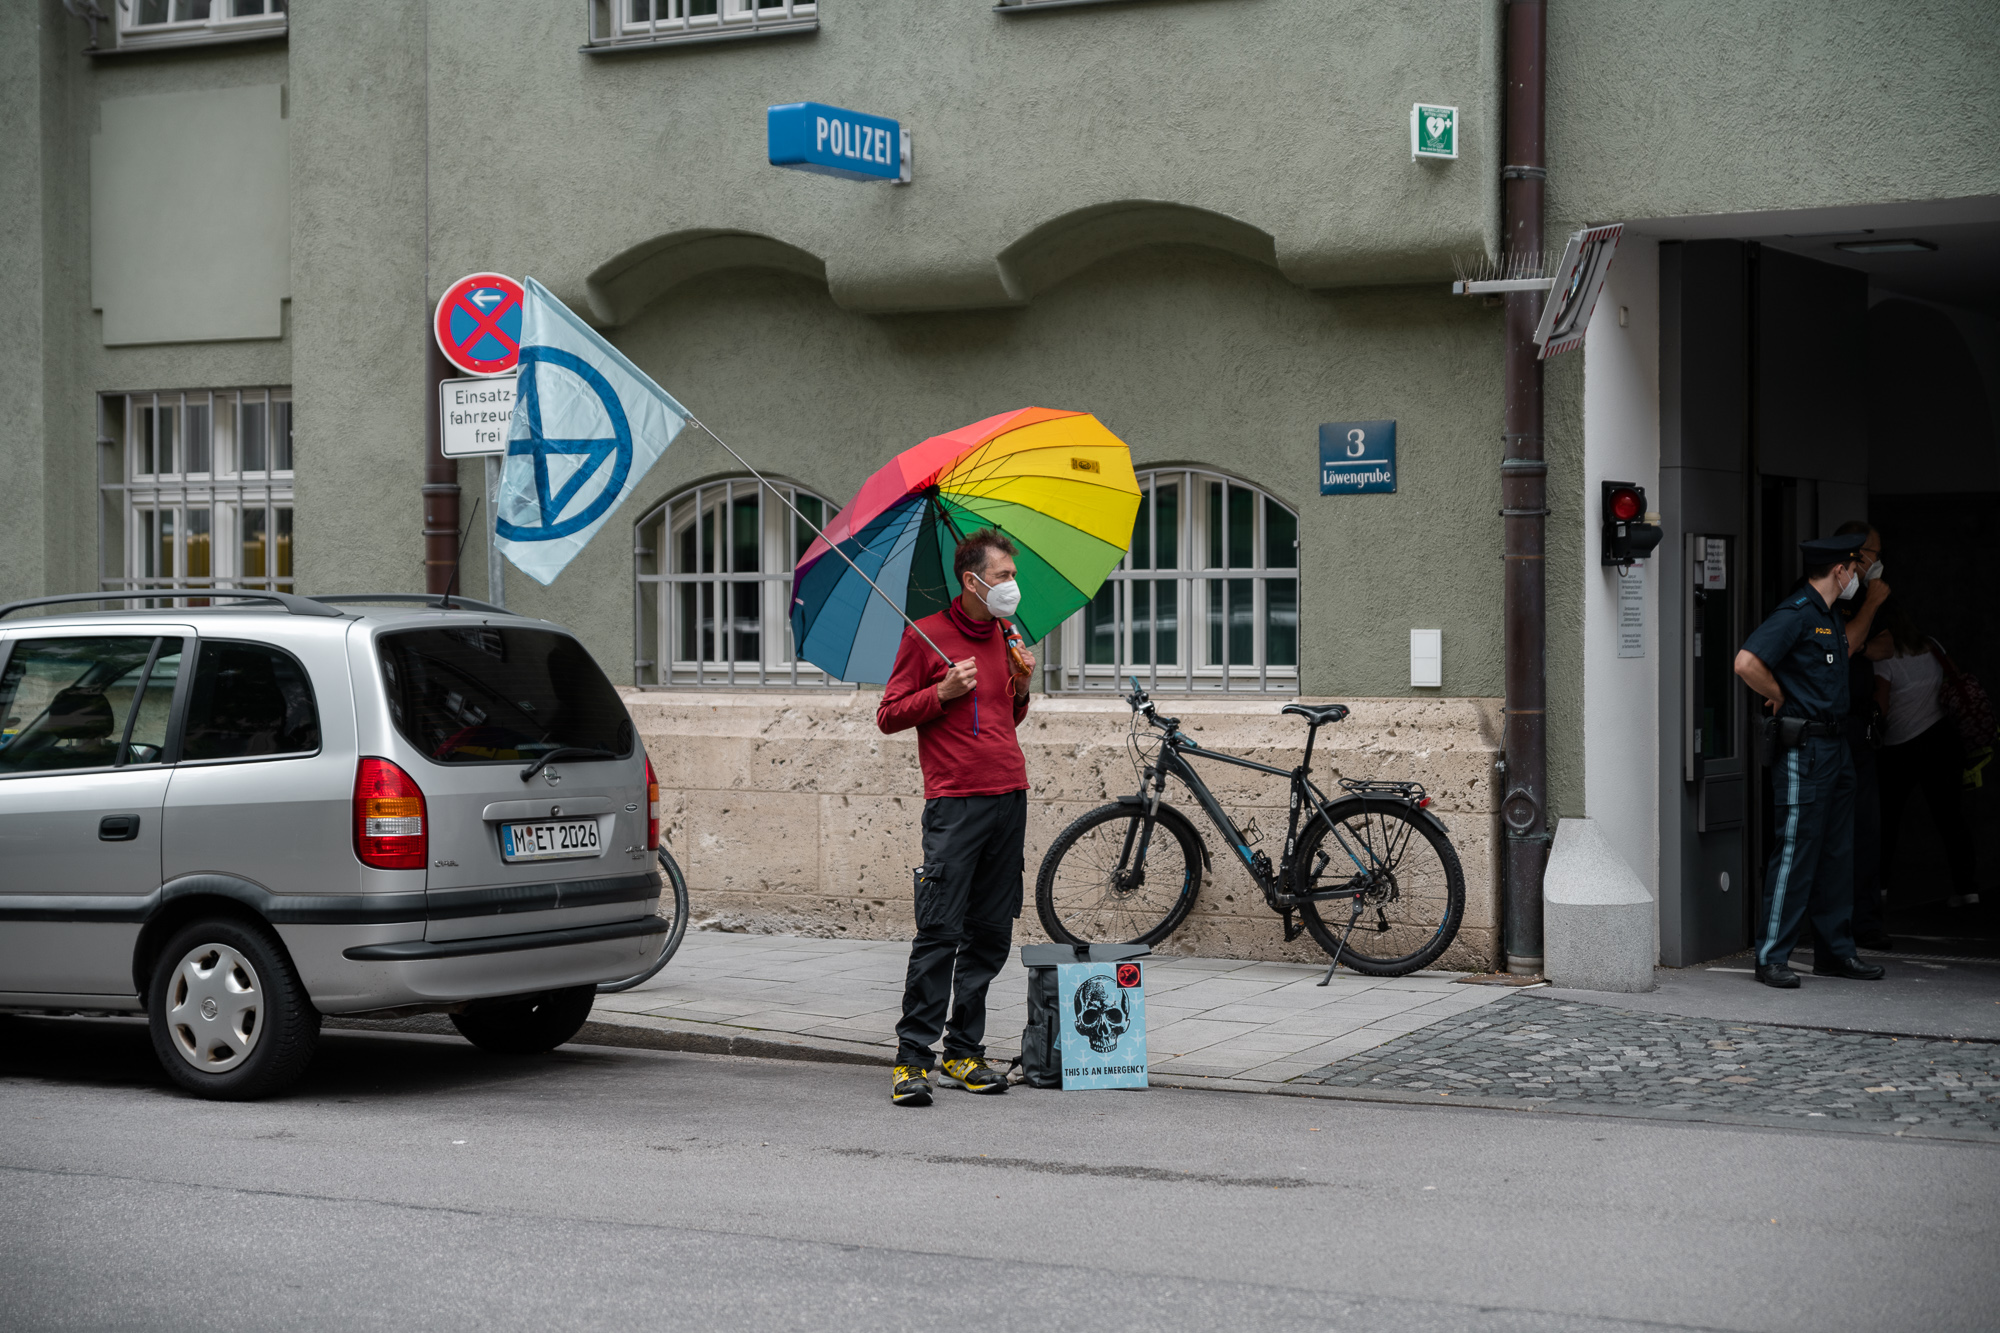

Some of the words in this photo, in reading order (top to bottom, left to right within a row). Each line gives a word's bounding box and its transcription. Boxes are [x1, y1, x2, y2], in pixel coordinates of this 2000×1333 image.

[816, 116, 891, 165] POLIZEI
[455, 389, 517, 405] Einsatz-
[475, 429, 500, 443] frei
[1346, 428, 1365, 457] 3
[1323, 468, 1391, 488] Löwengrube
[513, 828, 526, 853] M
[535, 826, 555, 851] ET
[559, 824, 597, 849] 2026
[1064, 1067, 1080, 1077] THIS
[1082, 1067, 1089, 1076] IS
[1091, 1066, 1102, 1076] AN
[1104, 1065, 1145, 1075] EMERGENCY
